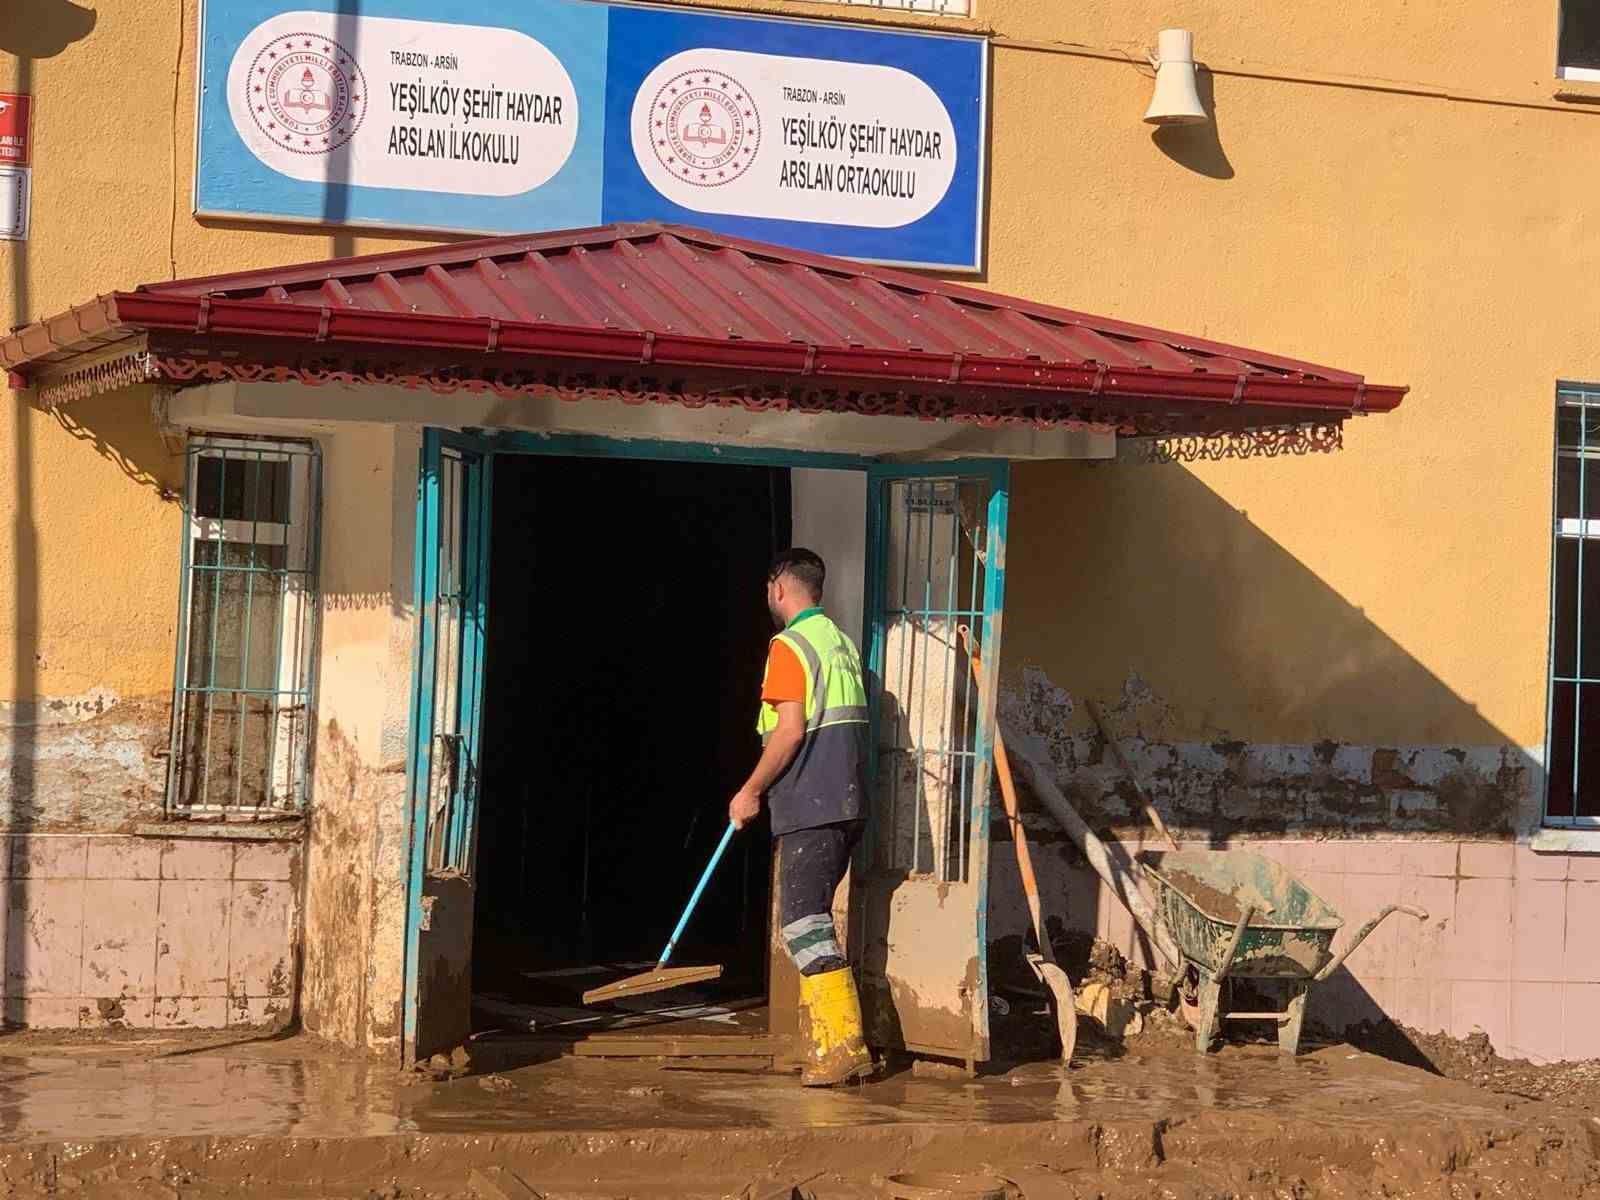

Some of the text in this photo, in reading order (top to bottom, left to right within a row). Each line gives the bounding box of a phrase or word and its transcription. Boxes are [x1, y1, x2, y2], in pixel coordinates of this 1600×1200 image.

[390, 50, 428, 68] TRABZON
[434, 53, 458, 70] ARSİN
[390, 77, 562, 125] YEŞİLKÖY ŞEHİT HAYDAR
[783, 86, 817, 104] TRABZON
[823, 89, 846, 105] ARSİN
[388, 123, 519, 165] ARSLAN İLKOKULU
[782, 112, 942, 160] YEŞİLKÖY ŞEHİT HAYDAR
[780, 160, 916, 199] ARSLAN ORTAOKULU
